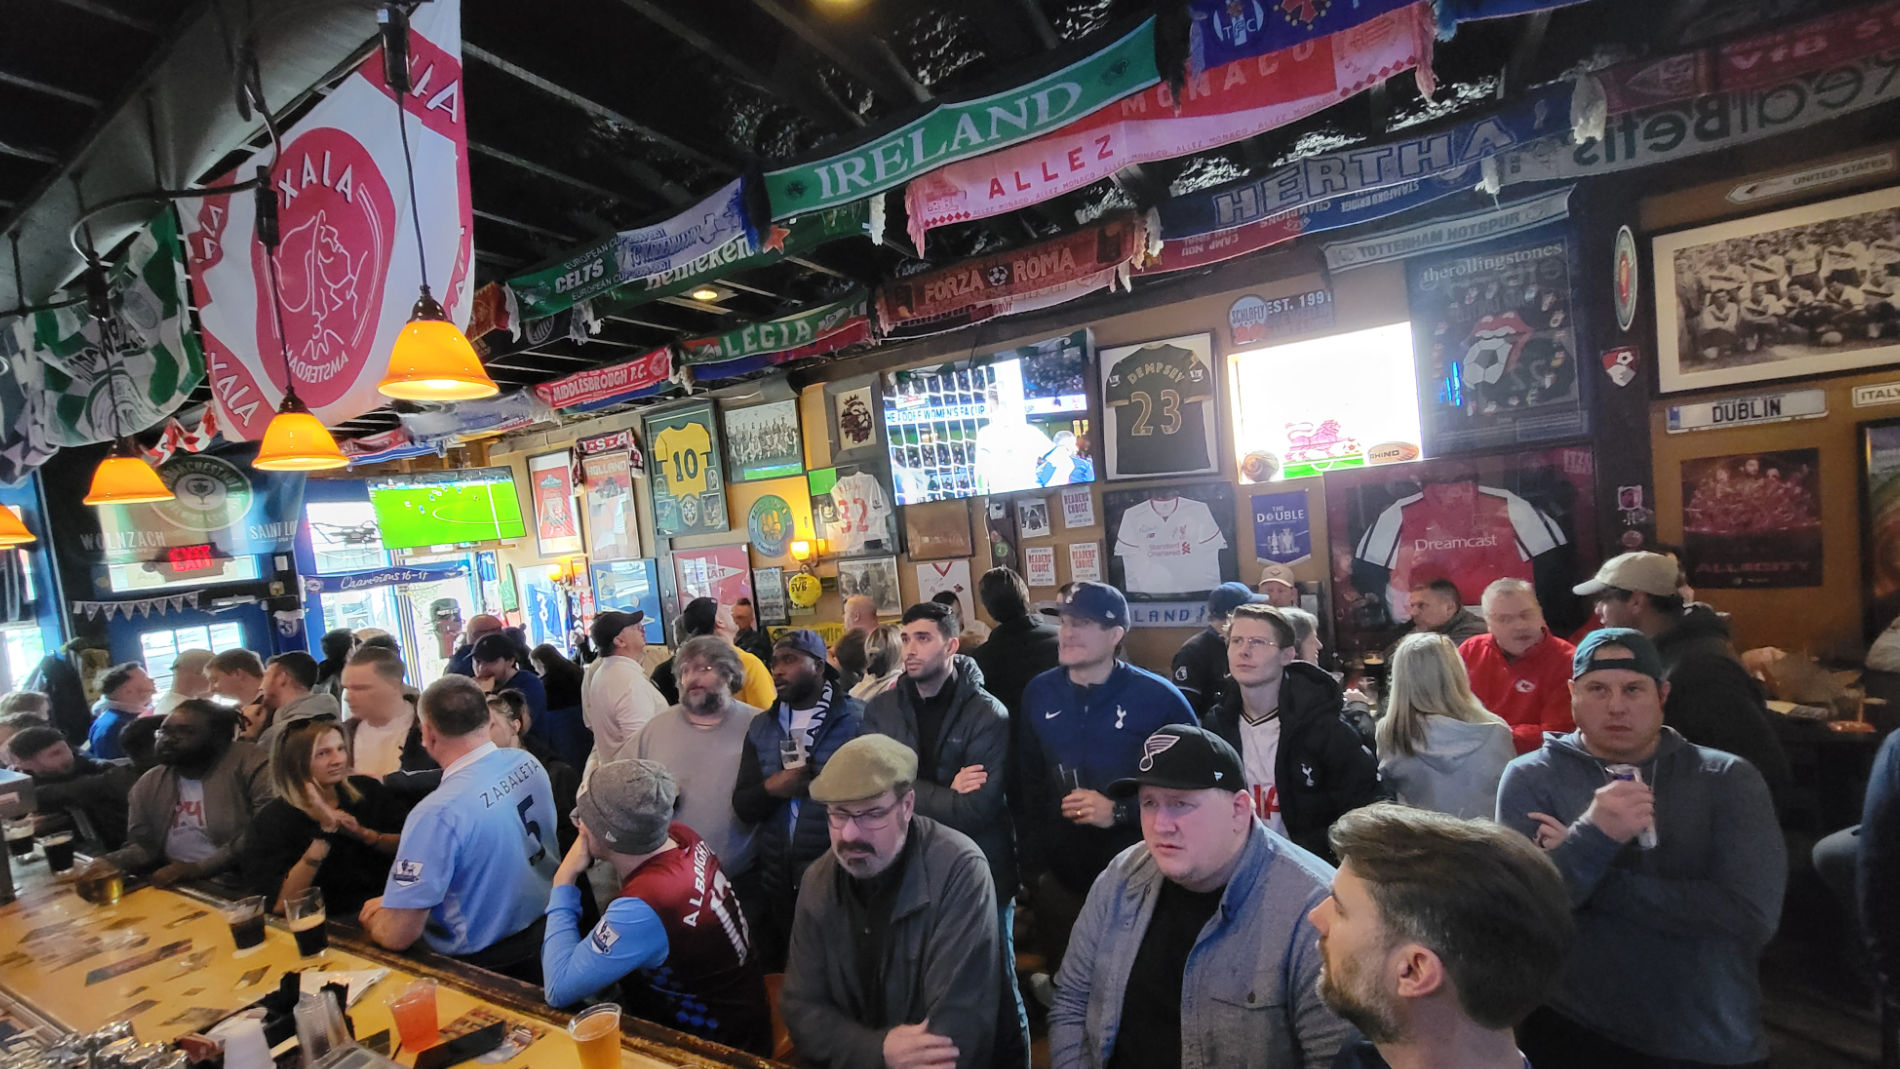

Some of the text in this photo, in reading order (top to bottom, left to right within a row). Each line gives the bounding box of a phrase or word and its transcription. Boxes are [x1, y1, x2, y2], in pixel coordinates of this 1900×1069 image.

[1121, 41, 1316, 116] MONACO
[814, 81, 1083, 200] IRELAND
[989, 134, 1113, 200] ALLEZ
[1063, 173, 1096, 189] MONACO
[1214, 112, 1517, 227] HERTHA
[1792, 168, 1838, 186] UNITED
[1181, 234, 1239, 257] CAMP NOU
[1358, 211, 1521, 258] TOTTENHAM HOTSPUR
[563, 243, 609, 270] EUROPEAN
[1422, 243, 1563, 283] therollingstones
[554, 258, 604, 294] CELTS
[571, 278, 613, 301] EUROPEAN
[924, 269, 985, 305] FORZA
[1012, 247, 1076, 283] ROMA
[1298, 290, 1332, 308] 1991
[722, 320, 813, 357] LEGIA
[552, 364, 628, 402] MIDDLESBROUGH
[1127, 362, 1185, 385] DEMPSEY
[1130, 389, 1182, 437] 23
[1711, 398, 1782, 424] DUBLIN
[587, 460, 627, 476] HOLLAND
[673, 447, 699, 482] 10
[249, 522, 282, 541] SAINT
[838, 497, 869, 534] 32
[1256, 509, 1305, 523] DOUBLE
[1414, 535, 1498, 552] Dreamcast
[480, 759, 540, 809] ZABALETA
[517, 794, 546, 867] 5
